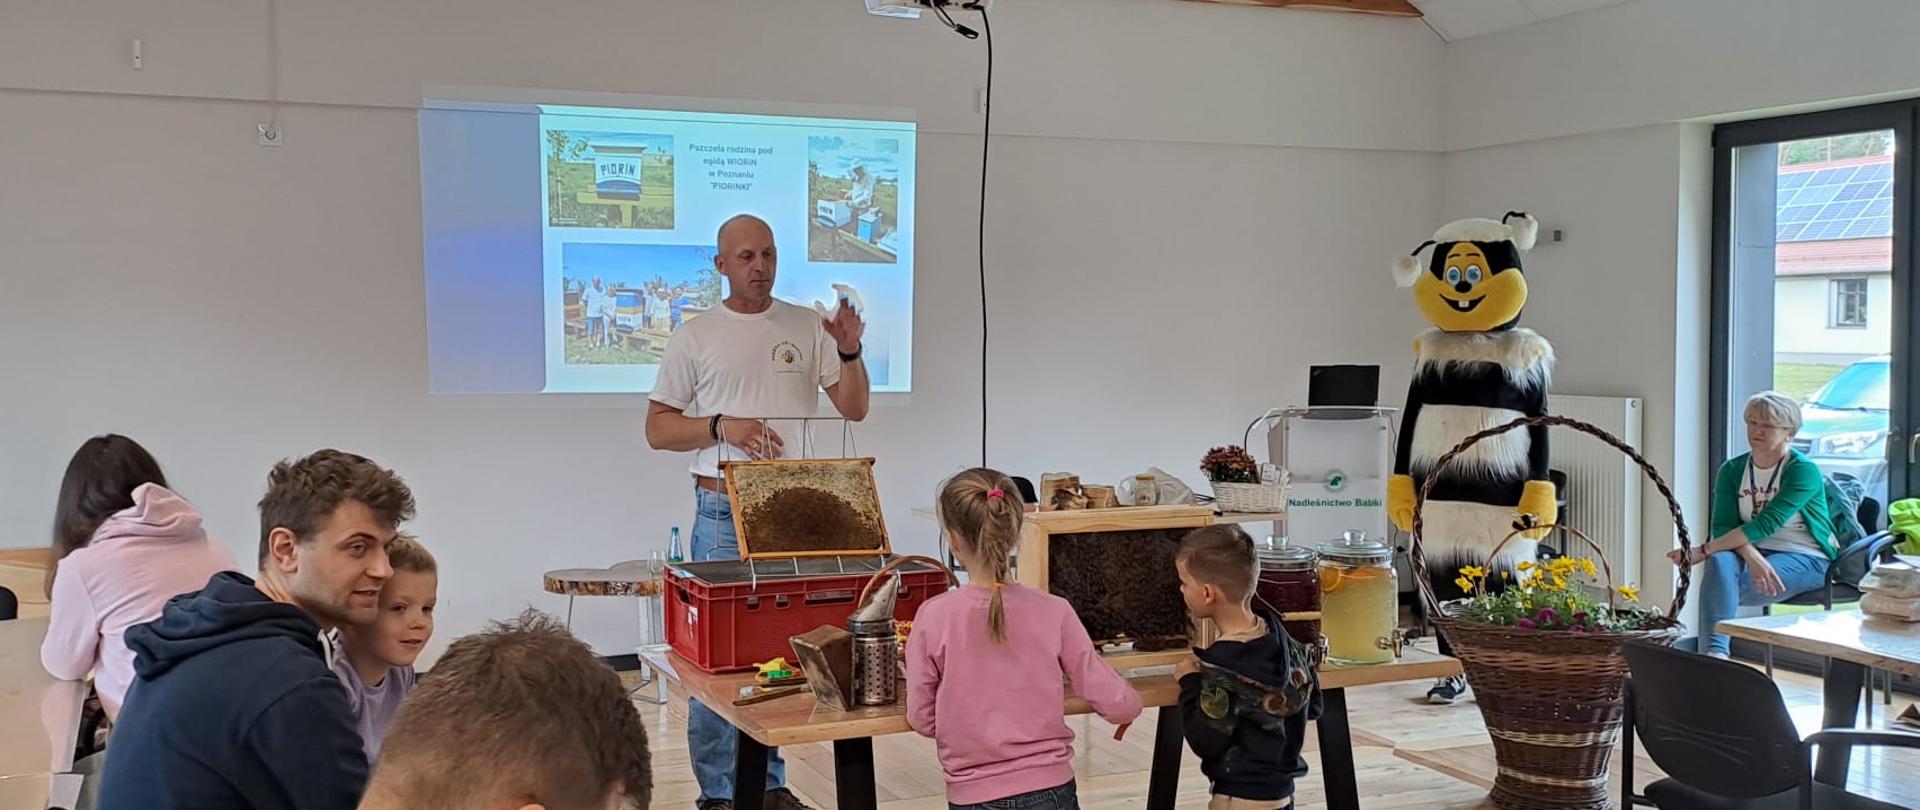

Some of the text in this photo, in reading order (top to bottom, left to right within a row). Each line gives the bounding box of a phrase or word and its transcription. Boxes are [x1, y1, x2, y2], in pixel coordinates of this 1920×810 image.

[727, 145, 756, 154] rodzina
[758, 147, 773, 155] pod
[600, 163, 636, 176] PIORIN
[717, 169, 754, 178] Poznaniu
[1288, 498, 1382, 507] Nadleśnictwo Babki
